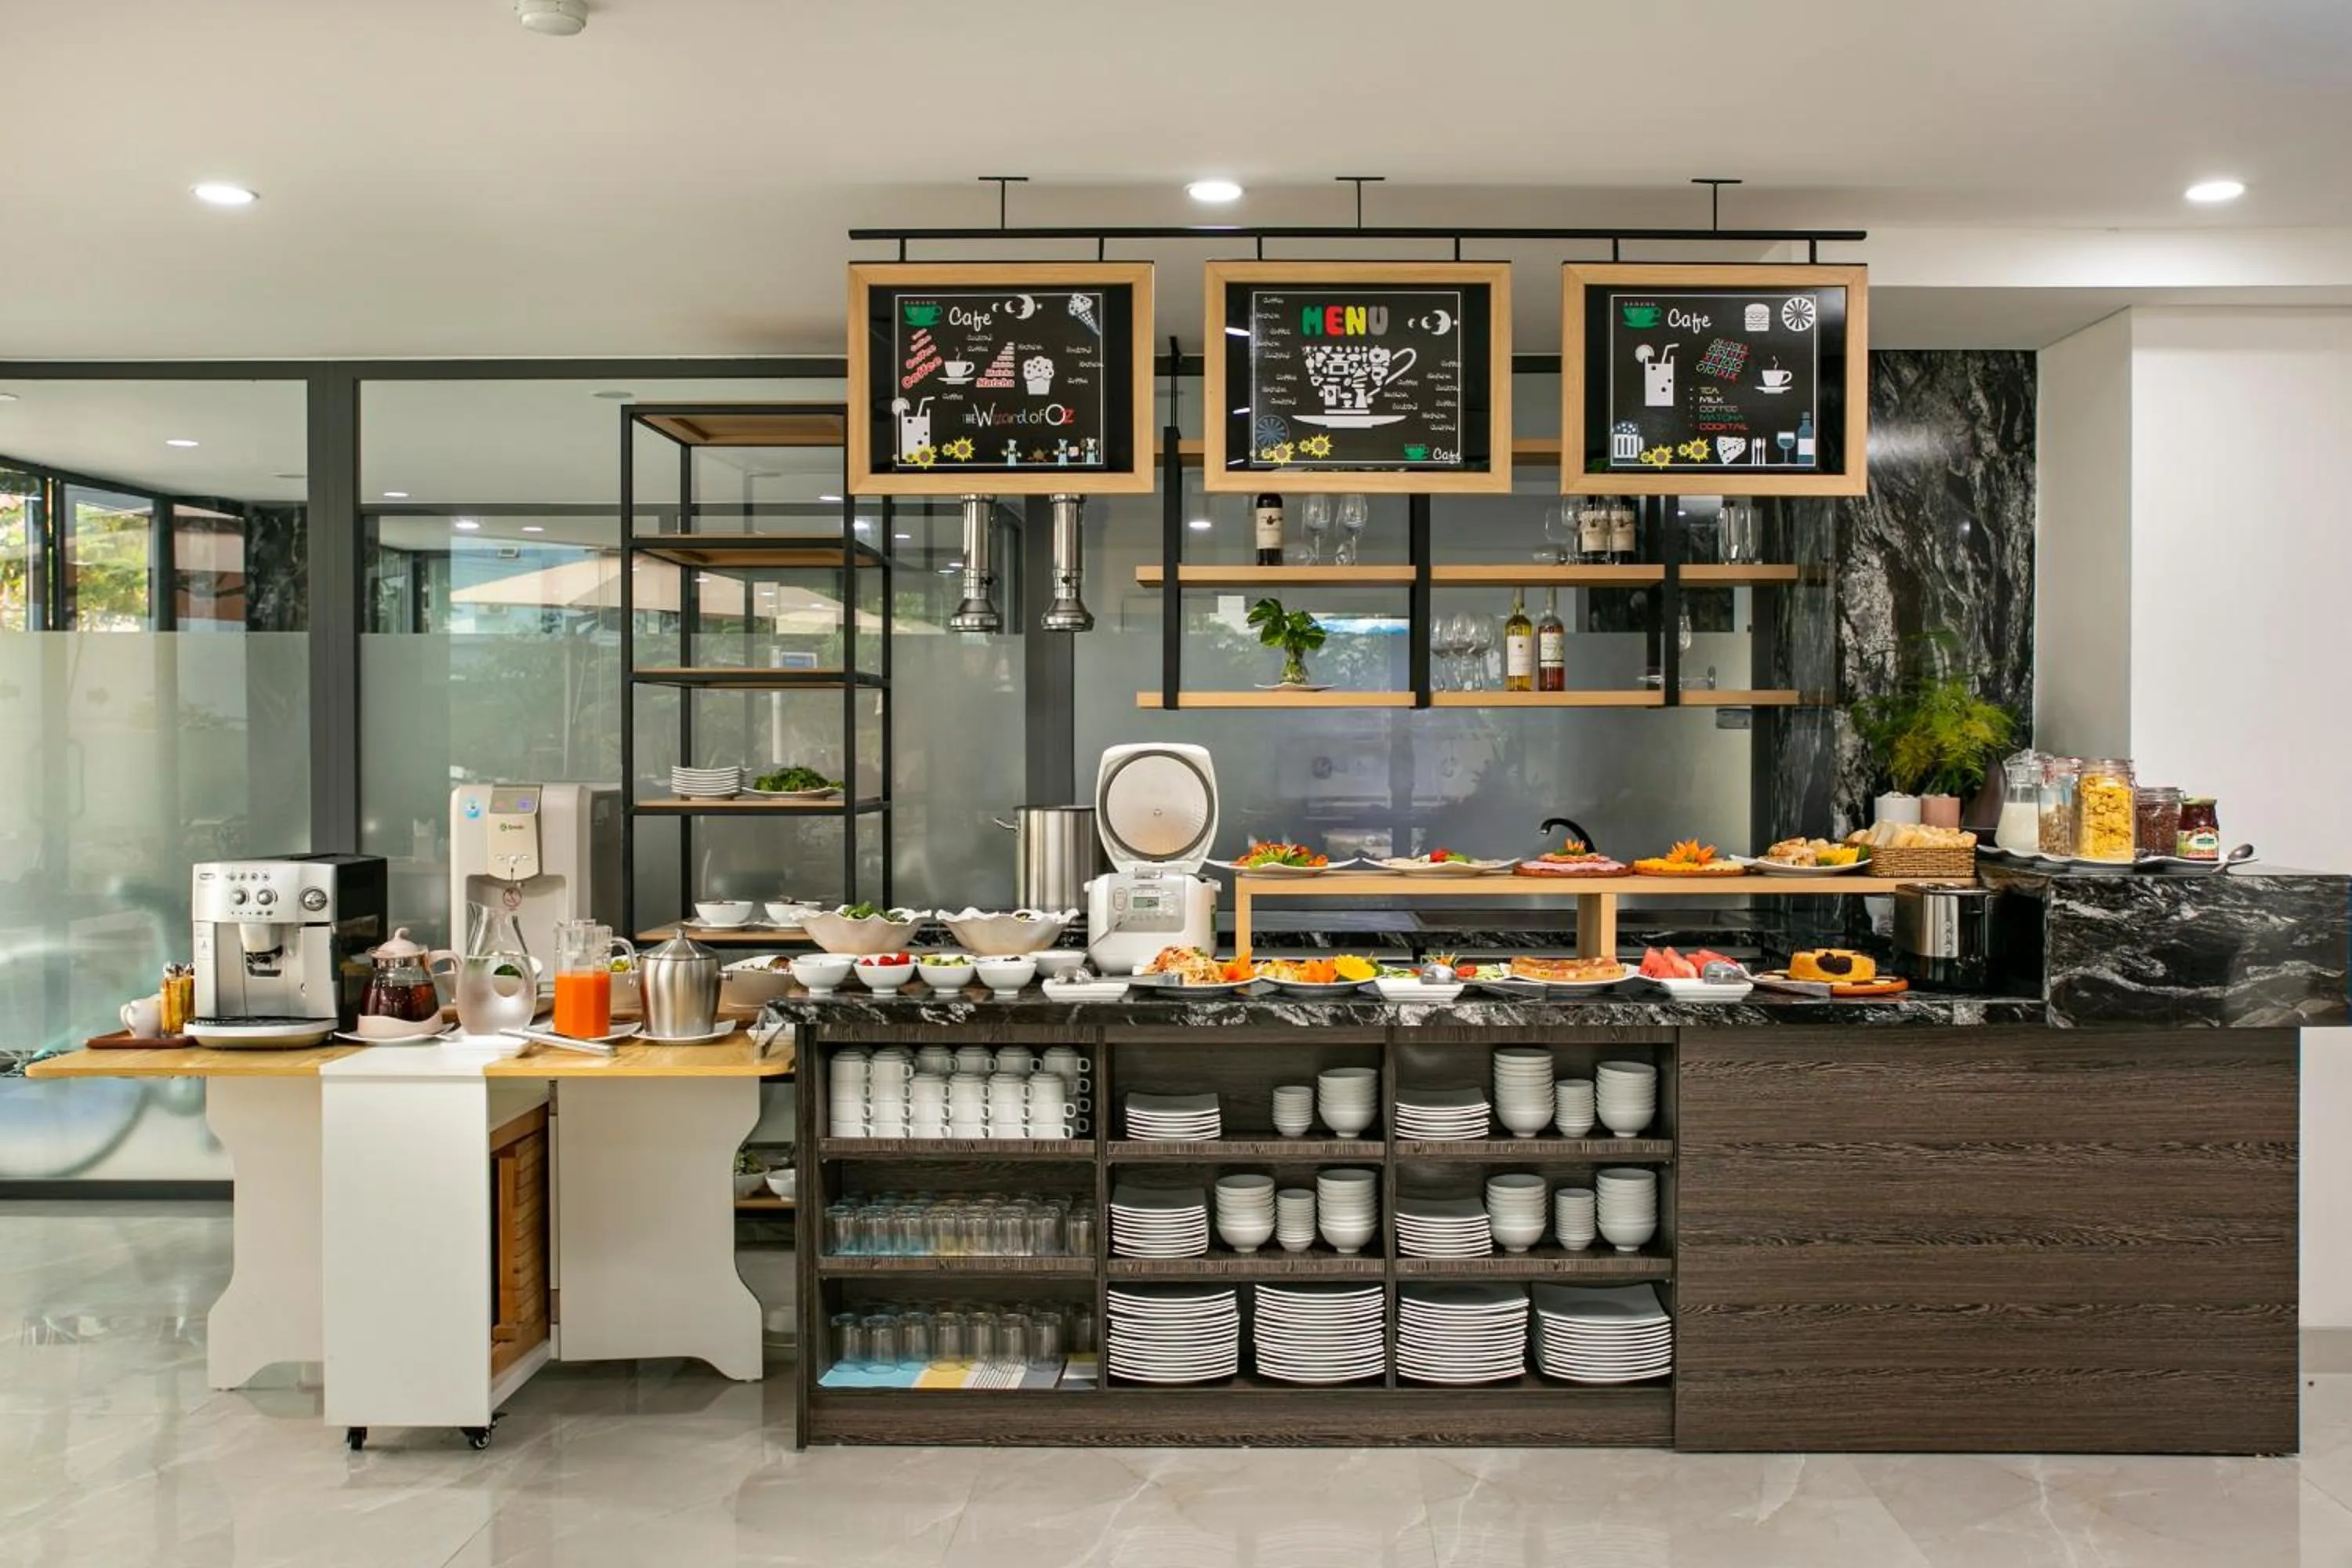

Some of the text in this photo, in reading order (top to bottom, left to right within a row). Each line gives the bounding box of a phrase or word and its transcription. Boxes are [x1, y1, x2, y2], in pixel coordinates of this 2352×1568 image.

[949, 307, 992, 332] Cafe
[1301, 306, 1388, 336] MENU
[1668, 308, 1711, 333] Cafe
[1029, 408, 1045, 424] of
